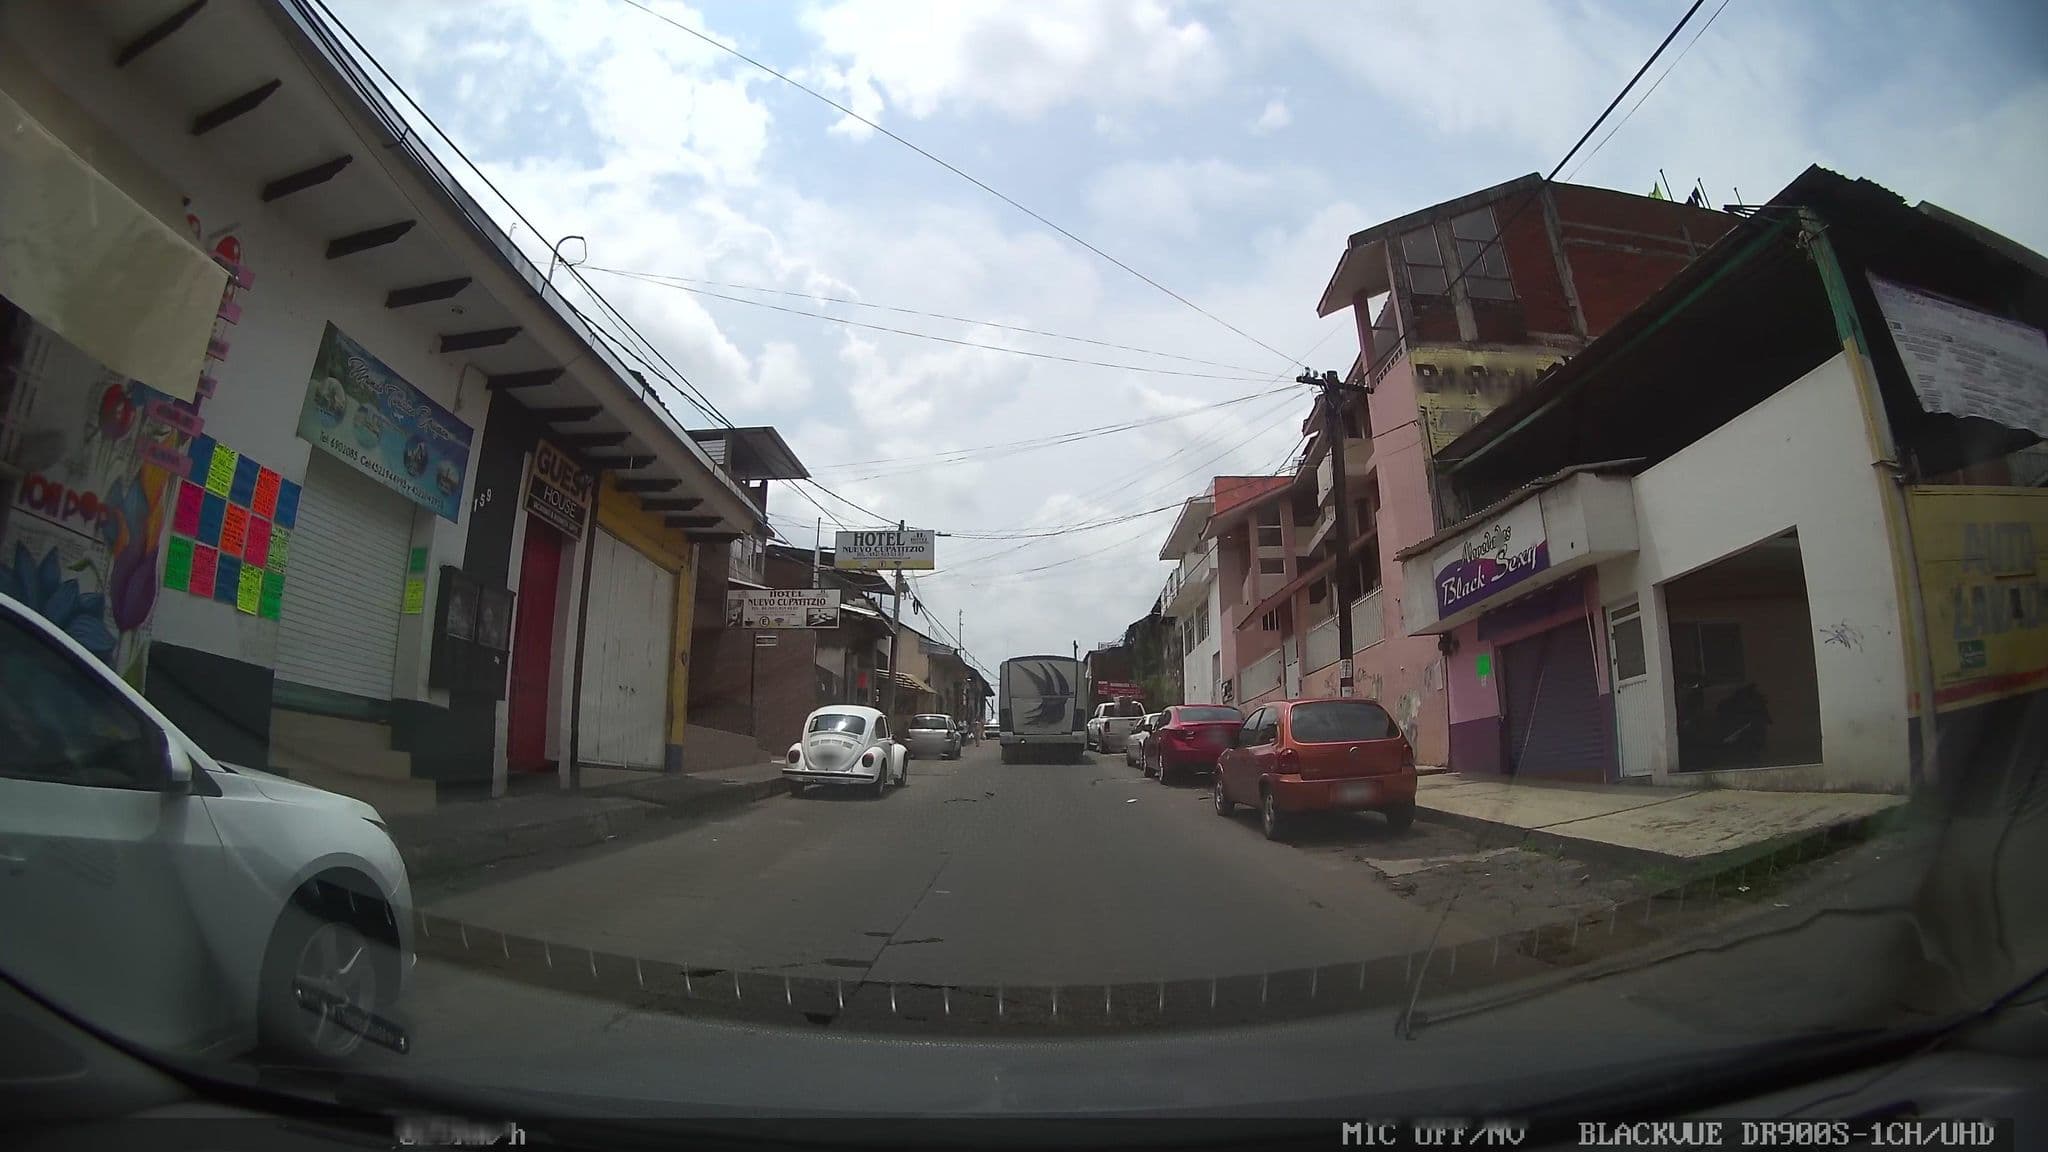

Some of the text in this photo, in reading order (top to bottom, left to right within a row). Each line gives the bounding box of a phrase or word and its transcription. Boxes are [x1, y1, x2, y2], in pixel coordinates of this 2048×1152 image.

[543, 486, 578, 519] HOUSE
[853, 532, 906, 546] HOTEL
[874, 545, 925, 553] CUPATITZIO
[1441, 543, 1537, 606] Black Sexy
[769, 590, 804, 598] HOTEL
[748, 598, 826, 606] NUEVO CUPATITZIO
